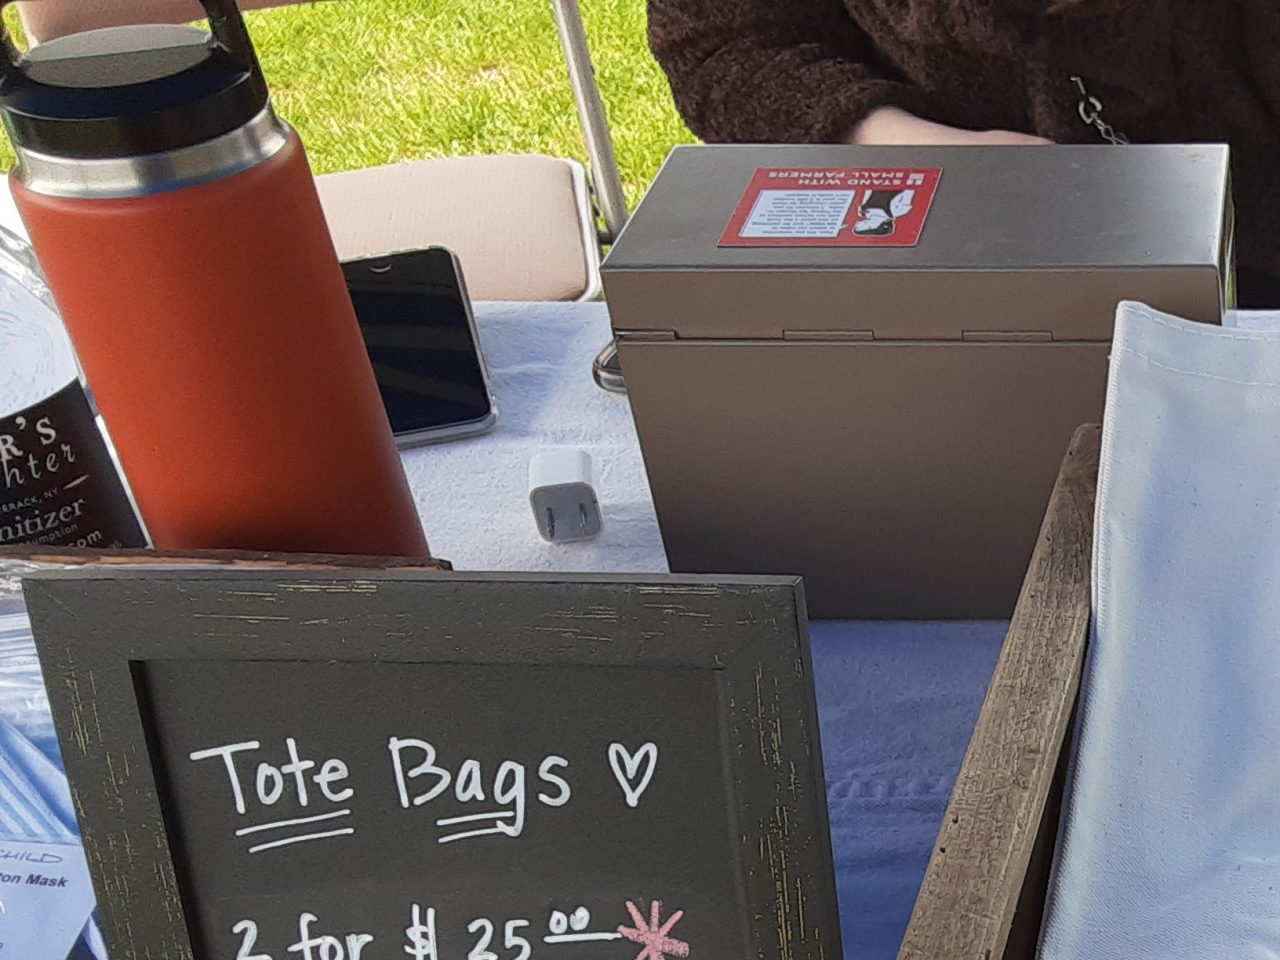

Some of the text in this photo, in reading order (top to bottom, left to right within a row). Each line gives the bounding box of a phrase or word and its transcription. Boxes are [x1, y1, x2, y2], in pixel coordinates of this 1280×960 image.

[768, 171, 904, 179] SMALL FARMERS
[798, 178, 841, 186] WITH
[0, 499, 85, 541] nitizer
[189, 736, 572, 838] Tote Bags
[25, 873, 69, 887] Mask
